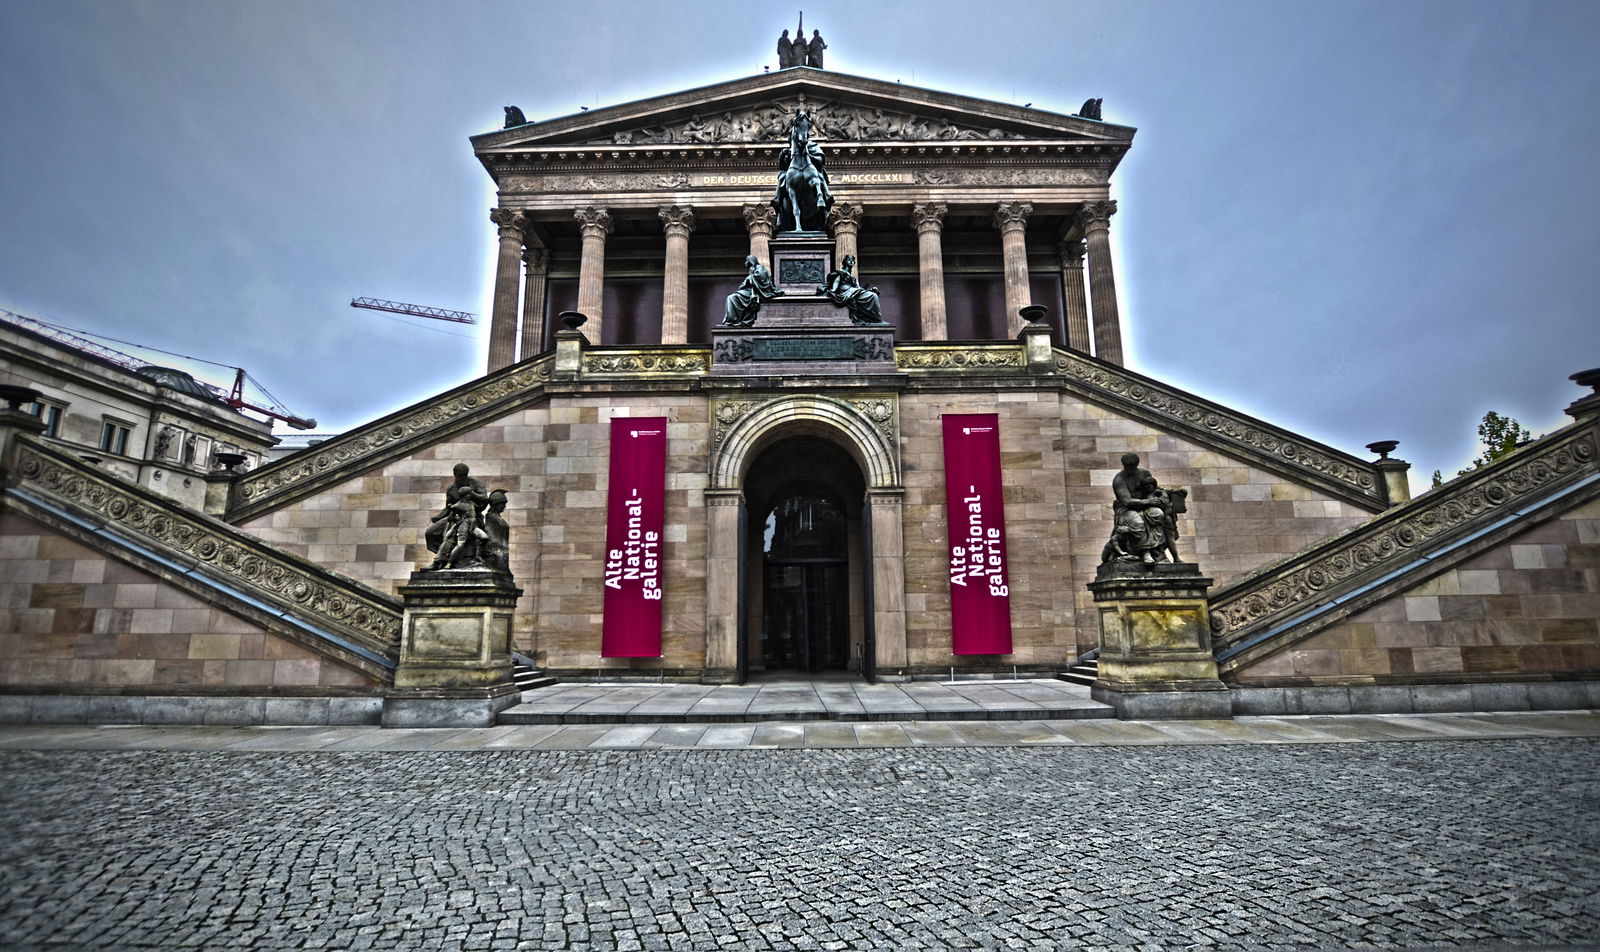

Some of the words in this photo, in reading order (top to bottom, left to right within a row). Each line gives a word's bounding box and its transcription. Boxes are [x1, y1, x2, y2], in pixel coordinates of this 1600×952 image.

[703, 176, 725, 184] DER
[841, 173, 903, 182] MDCCCLXXI
[623, 488, 642, 580] National-
[640, 531, 662, 600] galerie
[964, 485, 985, 577] National-
[985, 527, 1009, 597] galerie
[605, 549, 623, 590] Alte
[950, 546, 967, 587] Alte
